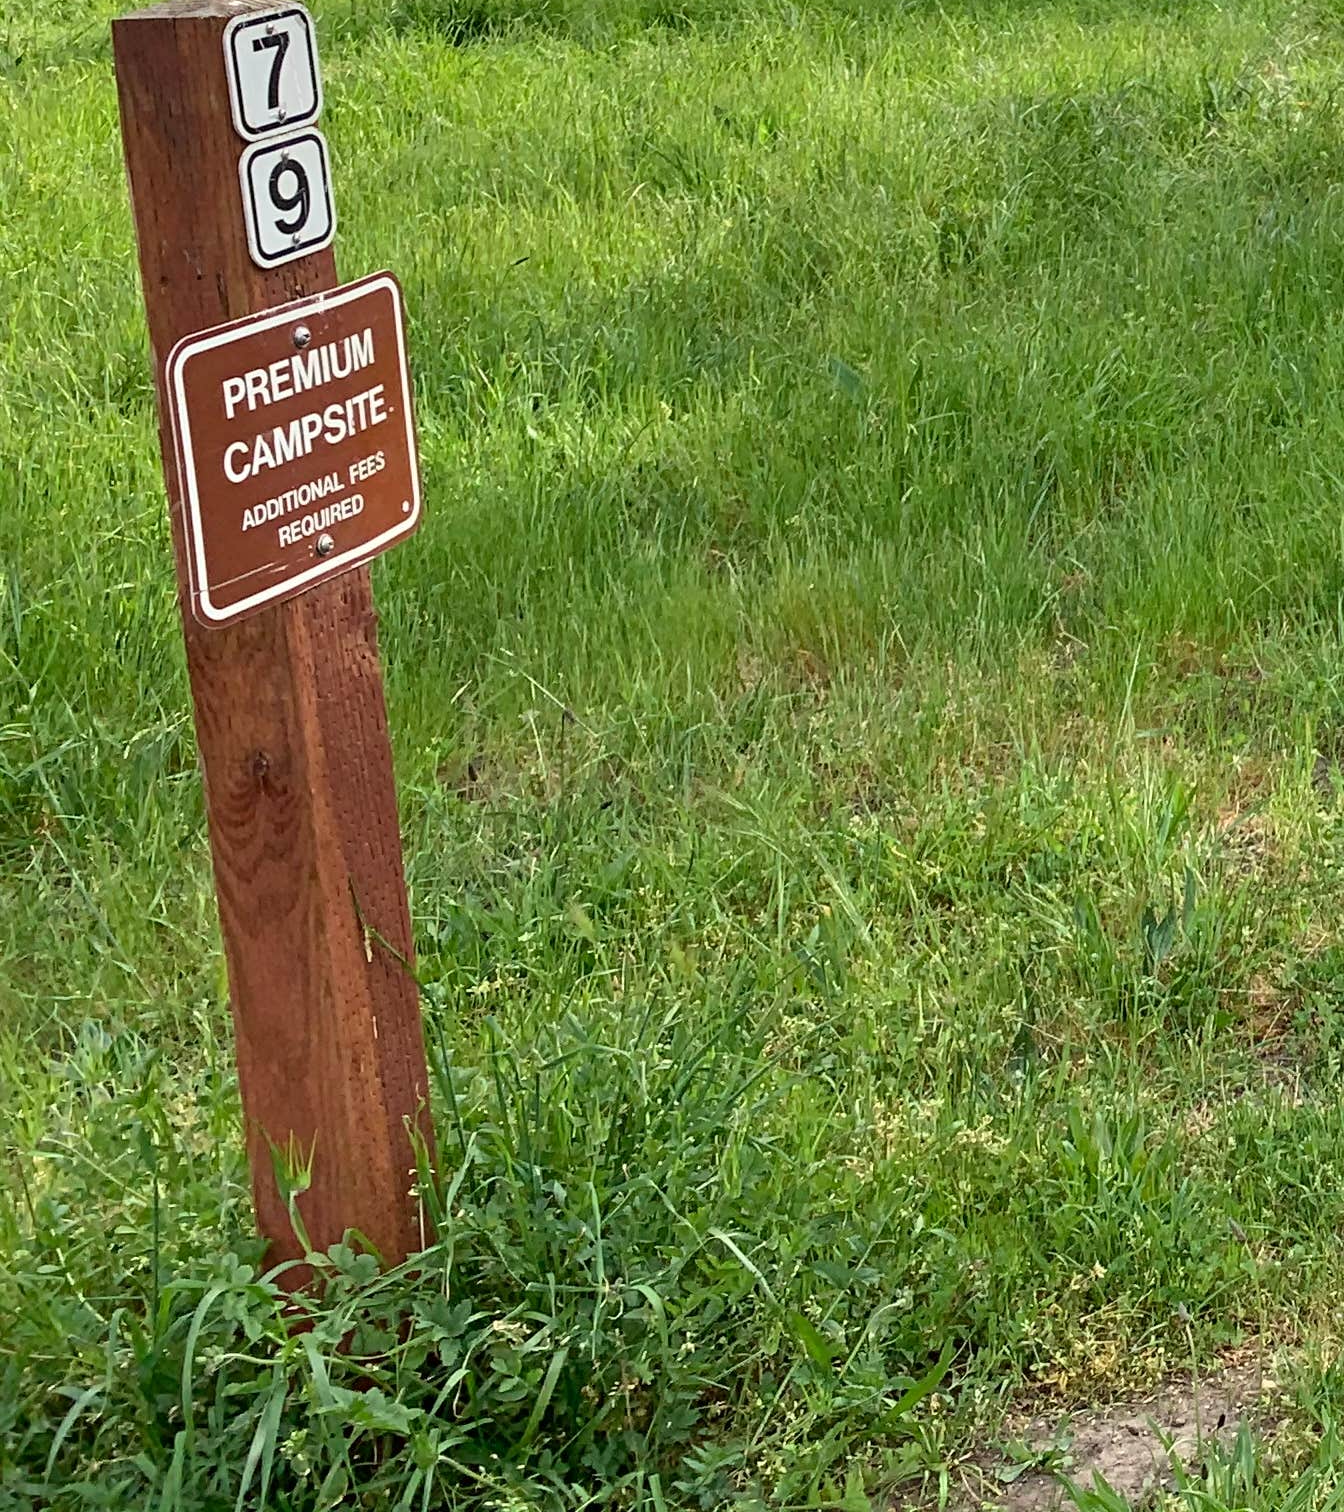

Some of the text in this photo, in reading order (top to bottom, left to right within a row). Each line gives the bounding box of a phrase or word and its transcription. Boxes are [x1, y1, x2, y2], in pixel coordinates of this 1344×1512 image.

[252, 31, 290, 110] 7
[268, 158, 311, 235] 9
[222, 327, 375, 420] PREMIUM
[223, 384, 387, 484] CAMPSITE
[241, 450, 386, 531] ADDITIONAL FEES
[278, 493, 364, 548] REQUIRED
